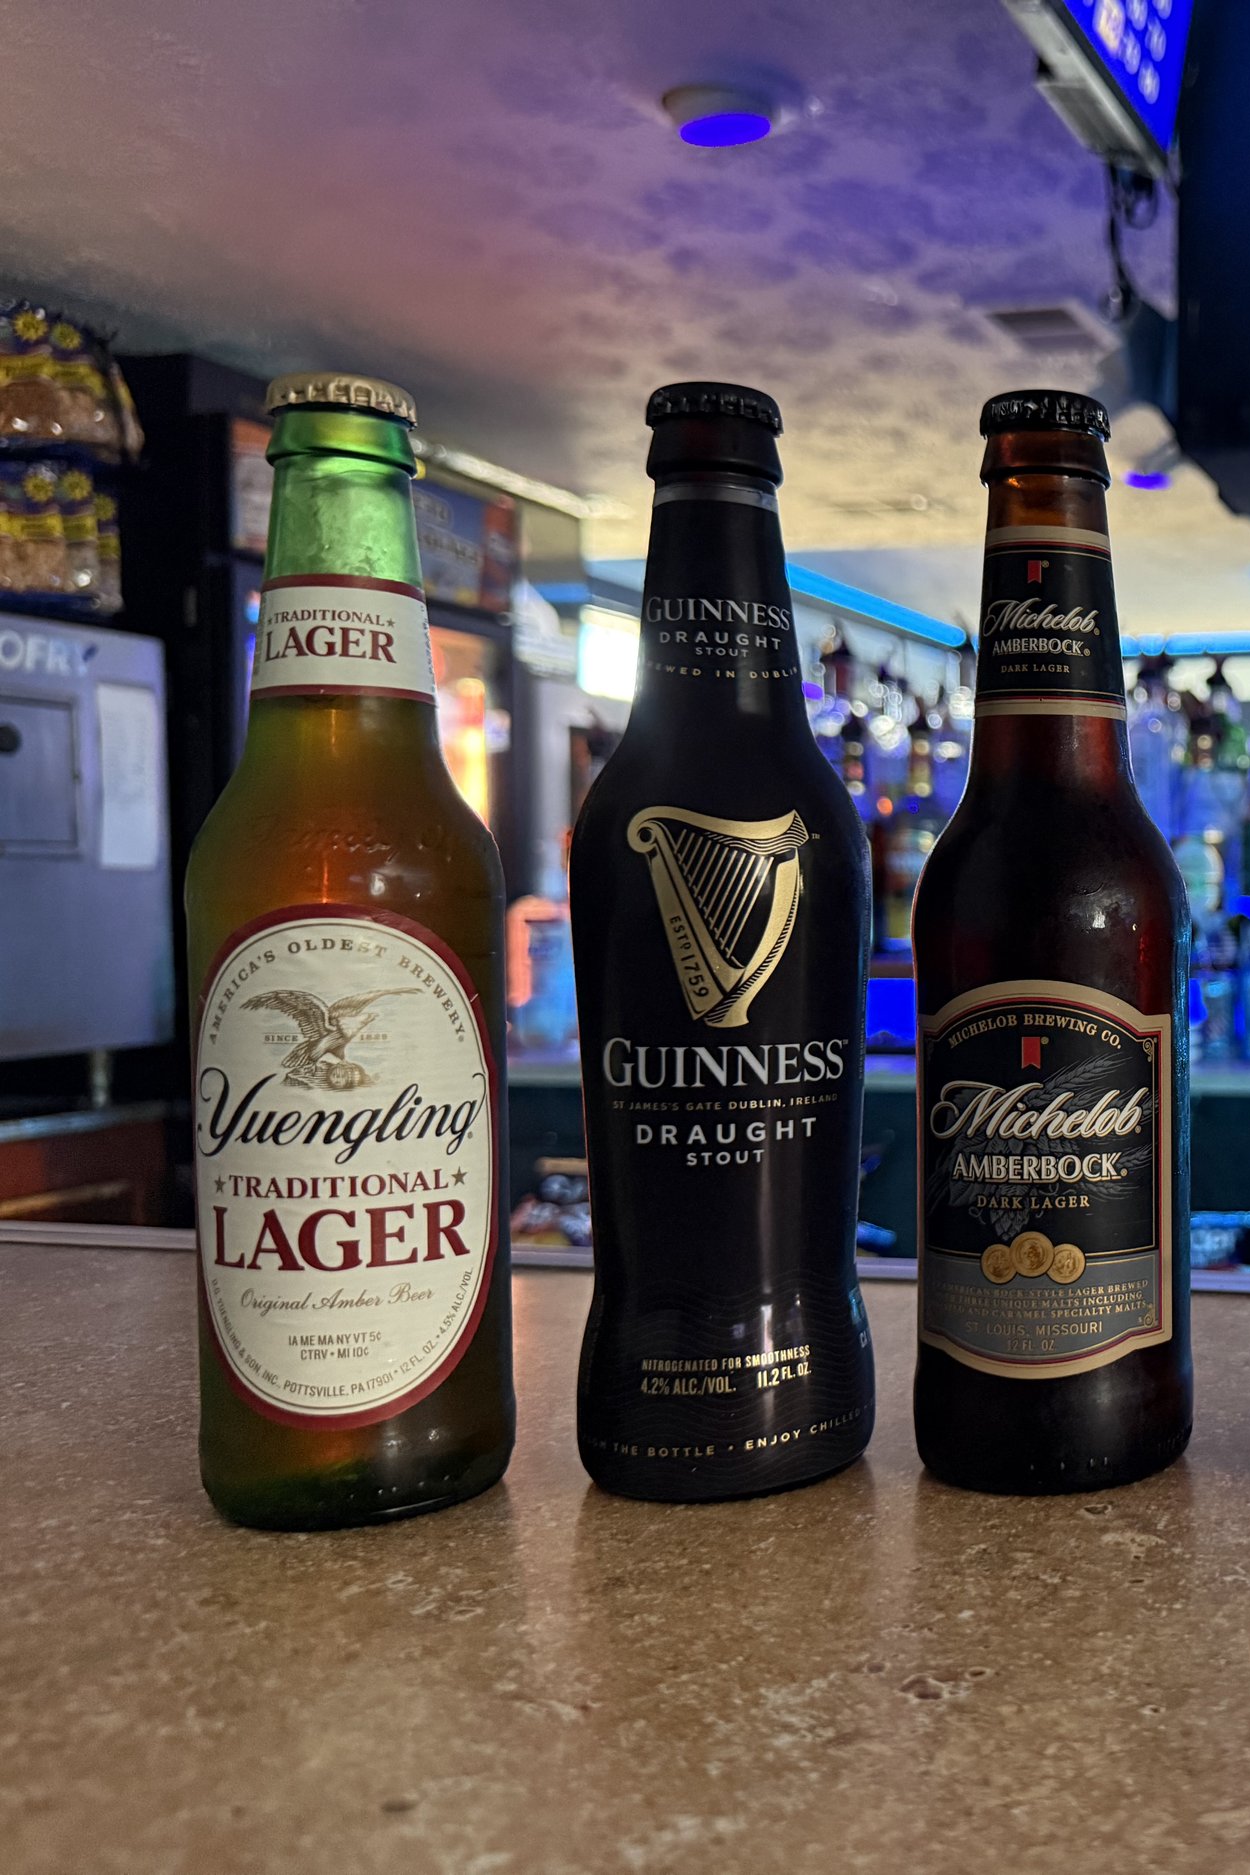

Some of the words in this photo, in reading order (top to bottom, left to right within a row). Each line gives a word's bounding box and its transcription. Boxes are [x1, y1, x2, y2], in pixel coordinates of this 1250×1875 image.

[273, 609, 386, 628] TRADITIONAL
[646, 597, 790, 631] GUINNESS
[983, 598, 1096, 636] Michelob
[264, 625, 397, 664] LAGER
[660, 631, 781, 649] DRAUGHT
[696, 647, 748, 658] STOUT
[992, 638, 1084, 656] AMBERBOCK
[717, 670, 735, 678] IN
[1001, 664, 1029, 673] DARK
[1033, 664, 1070, 673] LAGER
[681, 954, 708, 998] 1759
[209, 950, 276, 1045] AMERICA'S
[288, 938, 387, 958] OLDEST
[398, 957, 465, 1036] BREWERY
[264, 1034, 298, 1043] SINCE
[949, 1014, 1017, 1048] MICHELOB
[1024, 1014, 1097, 1036] BREWING
[1101, 1030, 1122, 1049] CO.
[603, 1038, 843, 1088] GUINNESS
[686, 1101, 722, 1111] GATE
[728, 1098, 786, 1110] DUBLIN,
[790, 1093, 838, 1106] IRELAND
[930, 1080, 1148, 1140] Michelob
[198, 1067, 487, 1165] Yuengling
[637, 1118, 817, 1144] DRAUGHT
[686, 1150, 765, 1166] STOUT
[953, 1152, 1122, 1183] AMBERBOCK
[229, 1169, 449, 1199] TRADITIONAL
[977, 1196, 1022, 1208] DARK
[1031, 1196, 1090, 1208] LAGER
[213, 1199, 471, 1272] LAGER
[241, 1287, 312, 1317] Original
[312, 1287, 385, 1311] Amber
[388, 1282, 435, 1305] Beer
[993, 1299, 1038, 1308] UNIQUE
[1041, 1298, 1080, 1308] MALTS
[1083, 1291, 1143, 1306] INCLUDING
[1068, 1286, 1104, 1297] LAGER
[1107, 1279, 1149, 1293] BREWED
[991, 1309, 1046, 1319] CARAMEL
[1050, 1306, 1112, 1318] SPECIALTY
[300, 1335, 315, 1346] ME
[317, 1335, 334, 1345] MA
[336, 1334, 352, 1345] NY
[353, 1332, 367, 1344] VT
[1036, 1320, 1103, 1336] MISSOURI
[300, 1349, 328, 1360] CTRV
[337, 1348, 350, 1359] MI
[351, 1382, 365, 1395] PA
[366, 1371, 394, 1391] 17901
[400, 1360, 411, 1374] 12
[439, 1312, 456, 1334] 4.5%
[641, 1359, 718, 1372] NITROGENATED
[722, 1357, 742, 1369] FOR
[745, 1345, 811, 1368] SMOOTHNESS
[640, 1377, 670, 1395] 4.2%
[757, 1367, 780, 1389] 11.2
[781, 1365, 796, 1380] FL.
[797, 1361, 812, 1377] OZ.
[647, 1446, 716, 1457] BOTTLE
[745, 1429, 801, 1450] ENJOY
[809, 1408, 861, 1435] CHILLED
